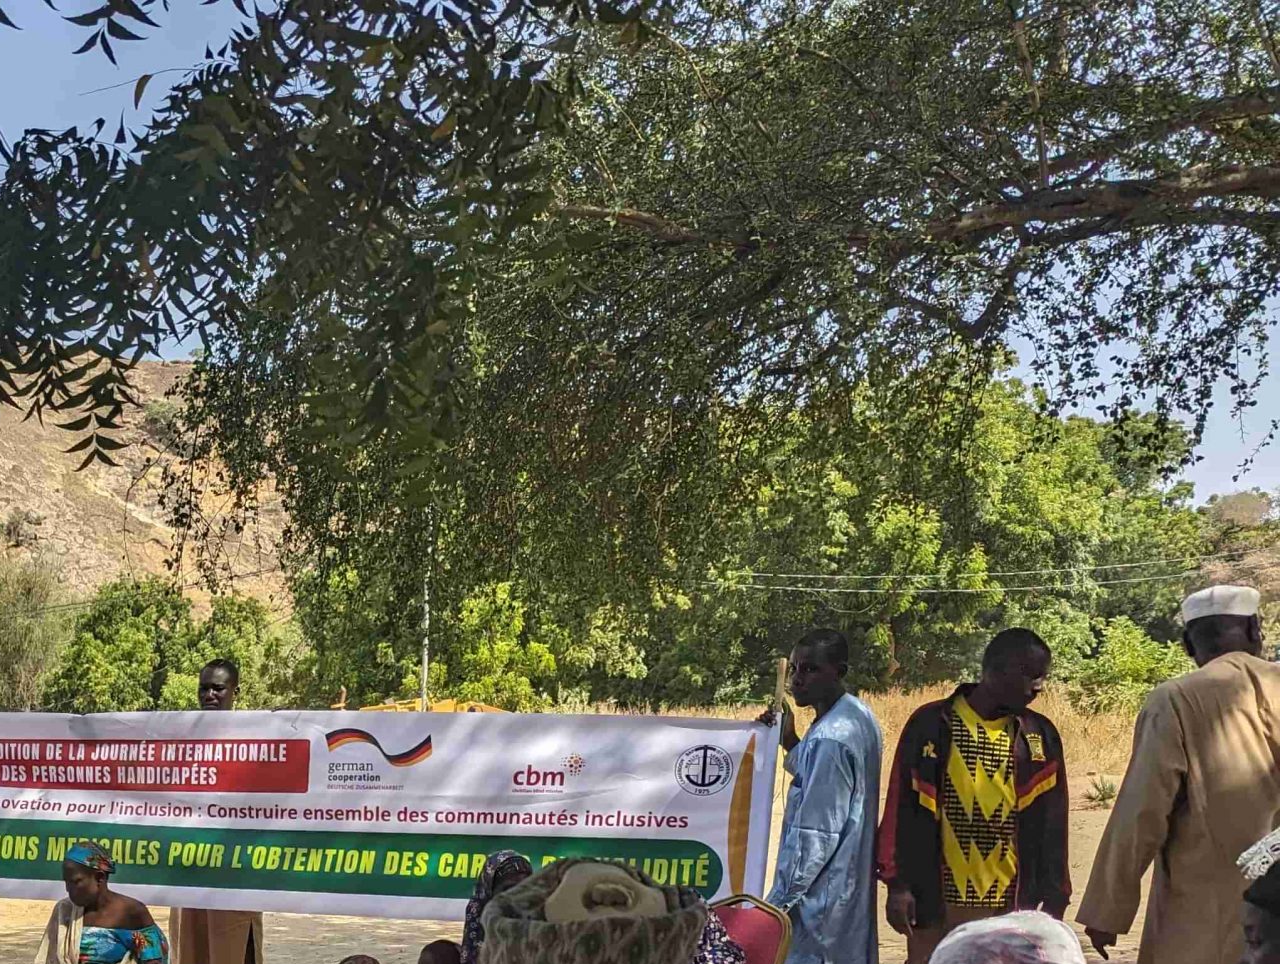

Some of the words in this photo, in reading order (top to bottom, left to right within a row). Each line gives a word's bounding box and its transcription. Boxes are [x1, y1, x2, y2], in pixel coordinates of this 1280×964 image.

[46, 743, 62, 761] DE
[68, 743, 85, 761] LA
[91, 741, 155, 762] JOURNÉE
[160, 743, 287, 762] INTERNATIONALE
[1, 765, 27, 783] DES
[32, 765, 111, 784] PERSONNES
[117, 763, 218, 785] HANDICAPÉES
[328, 762, 373, 774] german
[328, 773, 381, 783] cooperation
[513, 764, 565, 786] cbm
[66, 802, 106, 816] pour
[109, 801, 193, 818] l'inclusion
[207, 804, 298, 820] Construire
[303, 806, 391, 822] ensemble
[397, 806, 429, 823] des
[435, 809, 578, 826] communautés
[584, 810, 689, 828] inclusives
[46, 836, 161, 866] MALES
[168, 842, 225, 868] POUR
[231, 845, 376, 875] L'OBTENTION
[383, 851, 429, 877] DES
